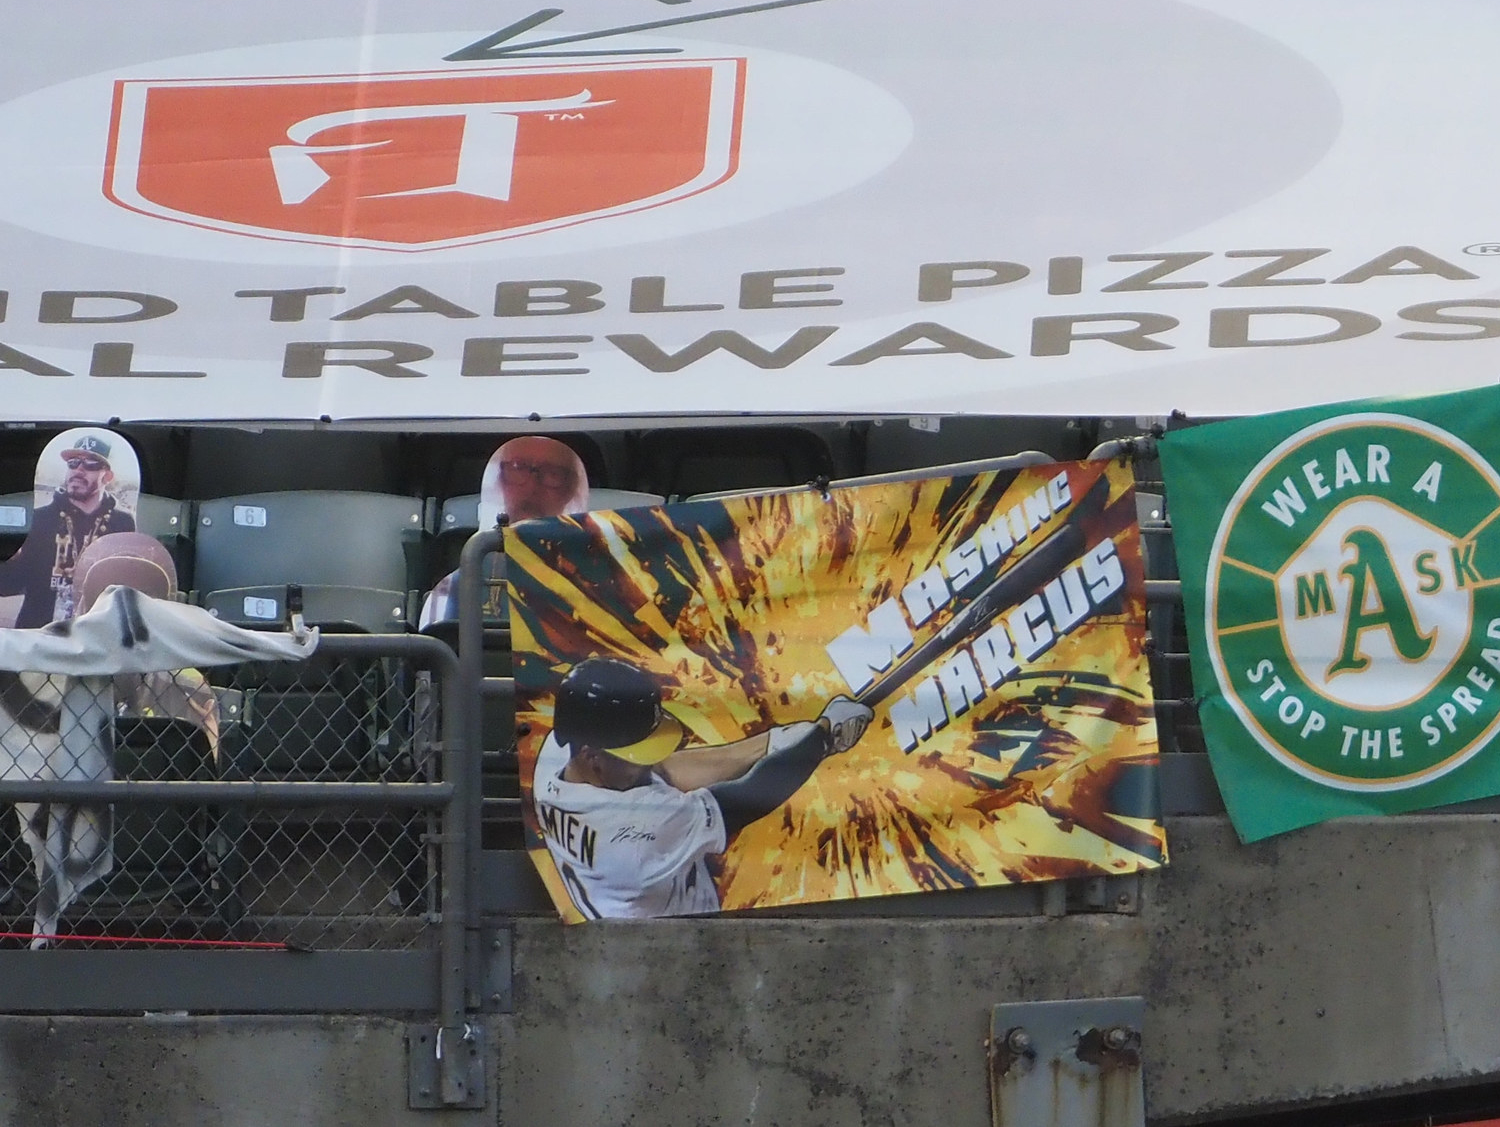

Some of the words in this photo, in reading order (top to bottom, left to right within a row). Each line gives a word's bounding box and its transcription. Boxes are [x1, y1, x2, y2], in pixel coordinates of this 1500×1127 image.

[234, 266, 845, 323] TABLE
[245, 508, 254, 524] 6
[1261, 444, 1391, 527] WEAR
[1412, 461, 1443, 502] A
[255, 599, 265, 616] 6
[826, 470, 1073, 696] MASHING
[889, 537, 1125, 755] MARCUS
[1246, 658, 1326, 739] STOP
[1340, 725, 1404, 760] THE
